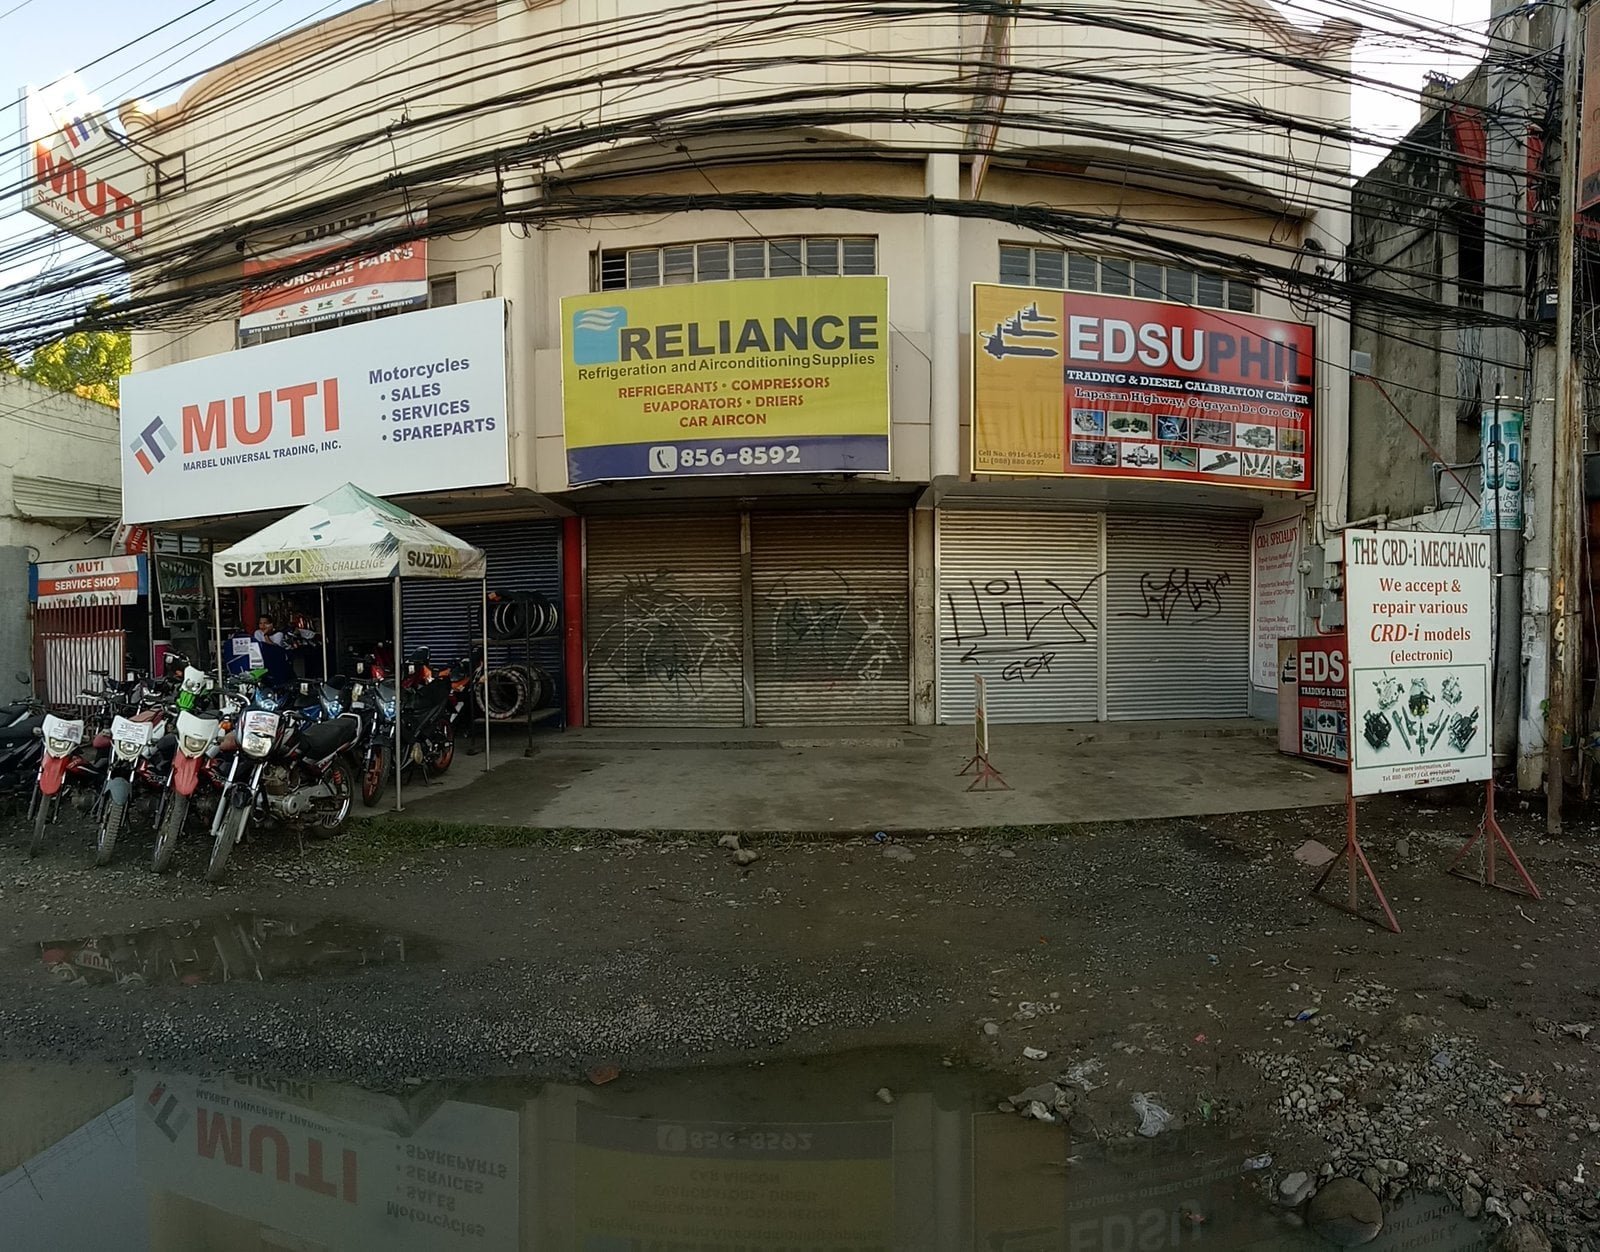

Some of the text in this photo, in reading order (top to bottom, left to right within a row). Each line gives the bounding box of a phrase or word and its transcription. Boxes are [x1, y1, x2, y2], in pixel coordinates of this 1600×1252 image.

[37, 142, 143, 240] MUTI
[37, 189, 74, 219] Service
[358, 247, 414, 271] PARTS
[303, 275, 355, 295] AVAILABLE
[620, 315, 879, 363] RELIANCE
[1069, 315, 1312, 386] EDSUPHIL
[368, 356, 471, 386] Motorcycles
[578, 352, 876, 381] Refrigeration and Airconditioning Supplies
[390, 382, 442, 403] SALES
[618, 377, 831, 399] REFRIGERANTS COMPRESSORS
[1067, 370, 1309, 405] TRADING & DIESEL CALIBRATION CENTER
[181, 376, 341, 455] MUTI
[391, 399, 471, 423] SERVICES
[643, 395, 804, 414] EVAPORATORS DRIERS
[1074, 387, 1128, 404] Lapasan
[1130, 391, 1186, 409] Highway,
[1187, 396, 1239, 415] Cagayan
[1258, 404, 1280, 418] Oro
[1281, 407, 1305, 422] City
[392, 416, 497, 443] SPAREPARTS
[679, 413, 767, 428] CAR AIRCON
[182, 439, 342, 472] MARBEL UNIVERSAL TRADING, INC.
[680, 446, 801, 467] 856-8592
[407, 550, 452, 569] SUZUKI
[1352, 536, 1488, 569] THE CRD-i MECHANIC
[76, 560, 104, 574] MUTI
[223, 557, 385, 578] SUZUKI 2016 CHALLENGE
[54, 576, 121, 592] SERVICE SHOP
[1379, 577, 1462, 597] We accept &
[1372, 600, 1468, 618] repair various
[1370, 623, 1471, 643] CRD-i models
[1390, 649, 1453, 665] (electronic)
[1301, 687, 1326, 697] TRADING
[1326, 687, 1332, 696] &
